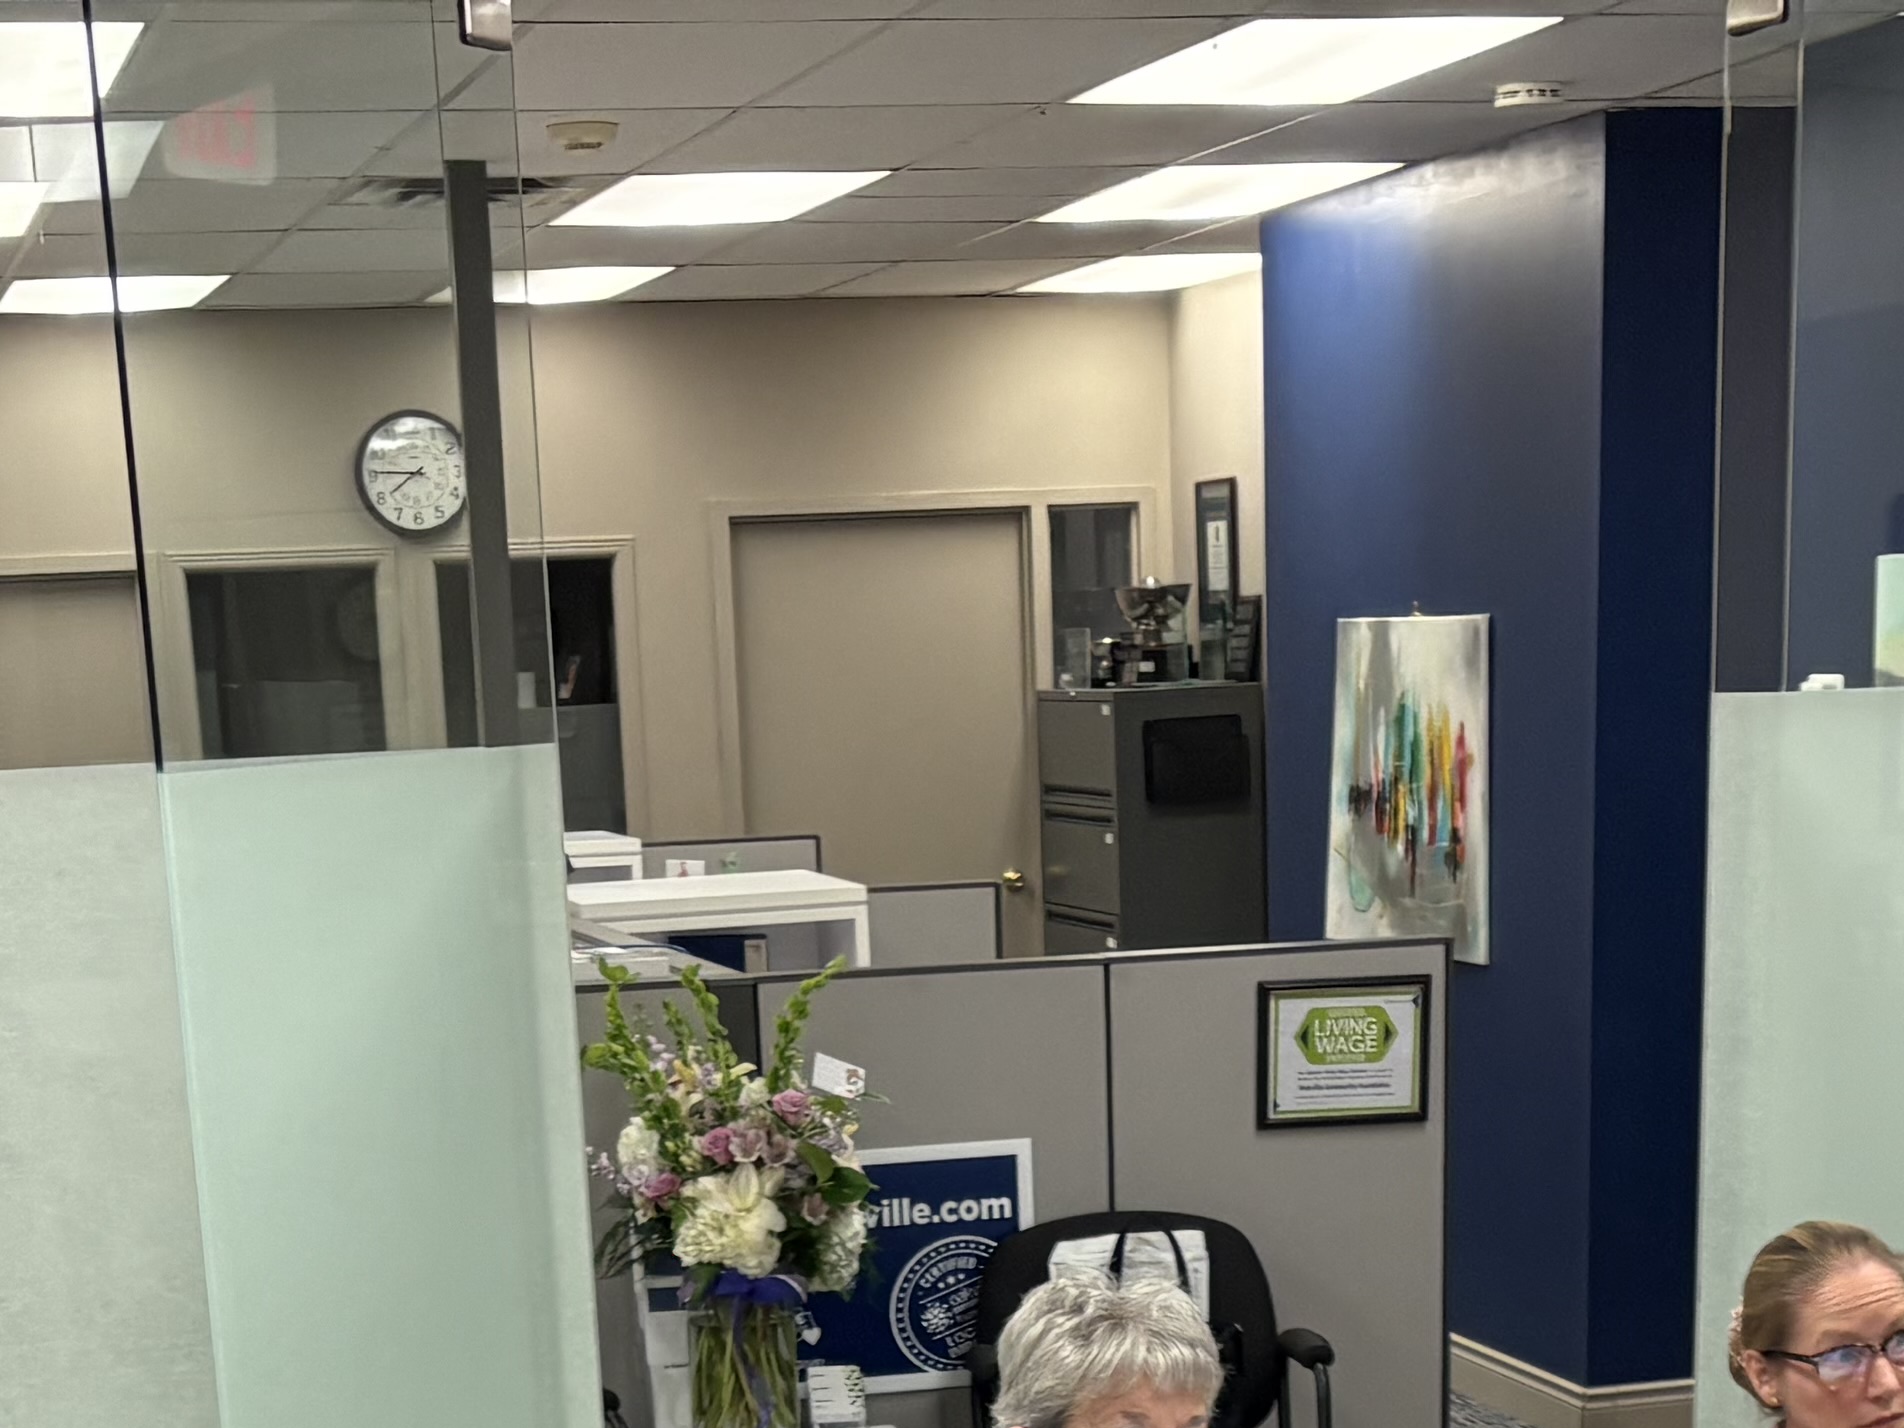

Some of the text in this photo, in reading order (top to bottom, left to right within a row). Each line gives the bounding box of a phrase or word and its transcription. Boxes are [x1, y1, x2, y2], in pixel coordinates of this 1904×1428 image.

[454, 465, 461, 479] 3
[377, 492, 386, 505] 8
[394, 507, 403, 521] 7
[414, 512, 424, 525] 6
[435, 505, 445, 519] 5
[1314, 1017, 1378, 1036] LIVING
[1315, 1035, 1377, 1053] WAGE
